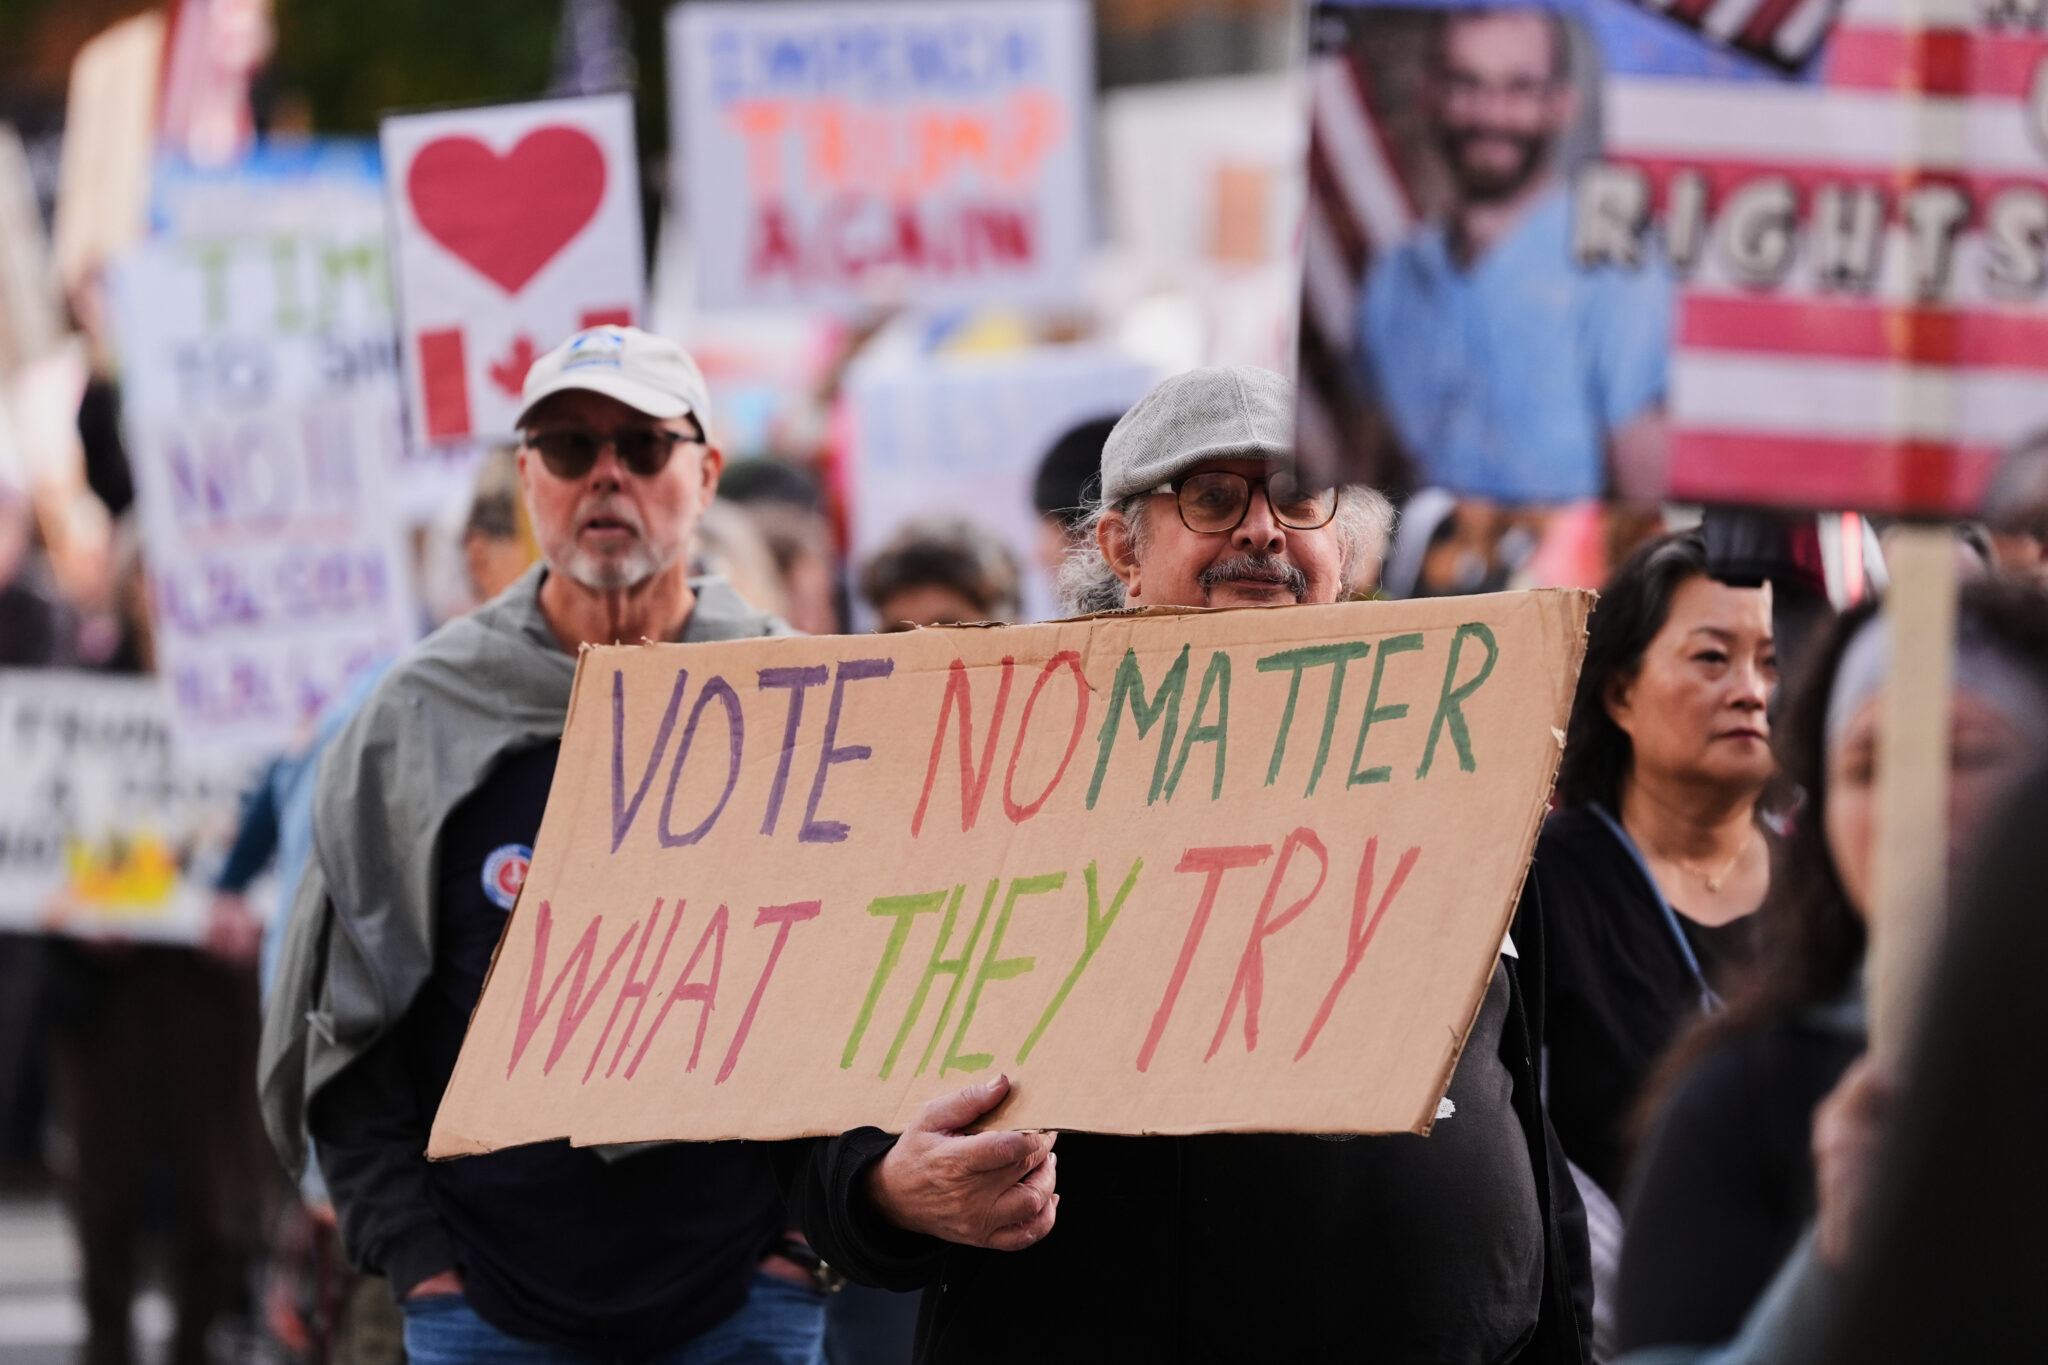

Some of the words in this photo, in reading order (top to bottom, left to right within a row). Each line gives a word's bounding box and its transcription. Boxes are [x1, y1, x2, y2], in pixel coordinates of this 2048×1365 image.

[708, 18, 1038, 102] IMPEACH
[727, 90, 1064, 200] TRUMP
[182, 235, 392, 332] TIM
[747, 196, 1036, 282] AGAIN
[1575, 160, 2048, 304] RIGHTS
[610, 658, 894, 853] VOTE
[911, 651, 1089, 838] NO
[1086, 622, 1498, 810] MATTER
[506, 897, 822, 1085] WHAT
[839, 857, 1143, 1081] THEY
[1136, 826, 1421, 1072] TRY
